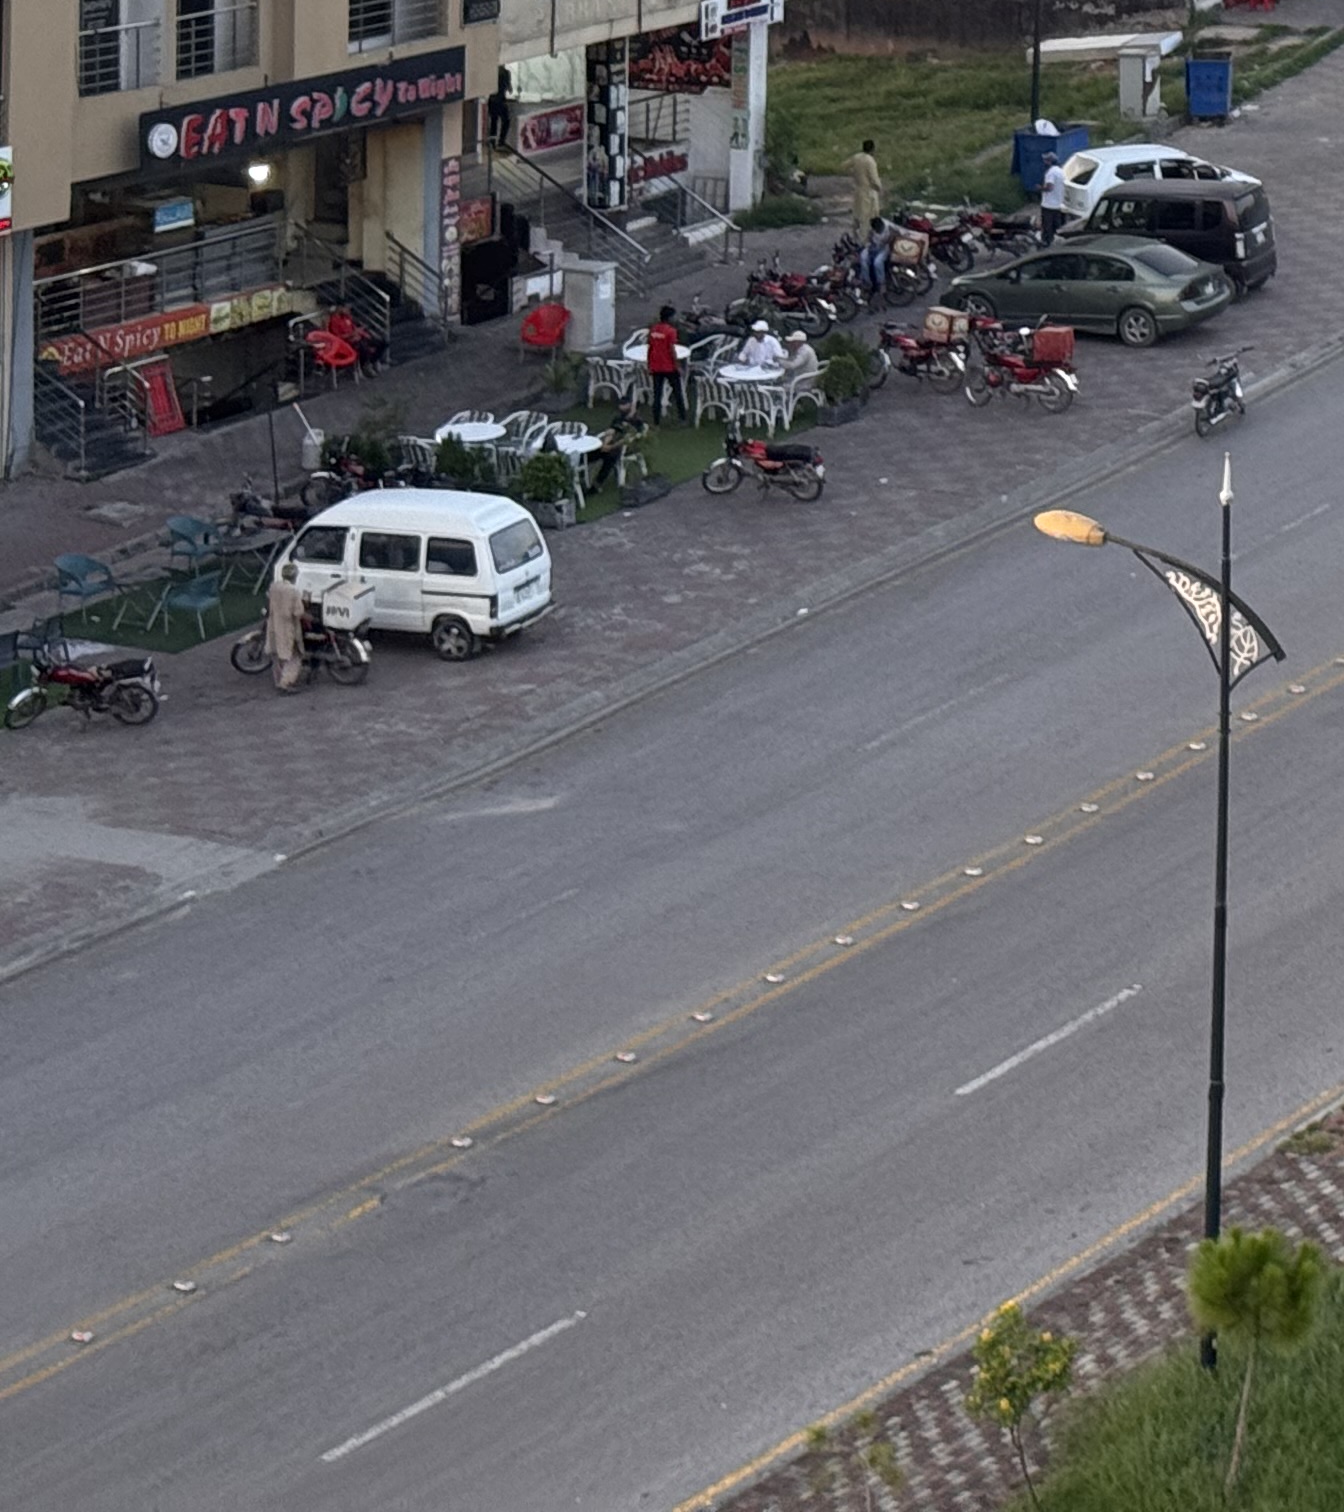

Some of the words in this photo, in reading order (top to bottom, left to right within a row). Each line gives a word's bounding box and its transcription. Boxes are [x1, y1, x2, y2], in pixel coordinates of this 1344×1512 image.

[180, 107, 249, 160] EAT
[256, 98, 280, 137] N
[290, 77, 395, 130] SPICY
[114, 324, 161, 357] Spicy
